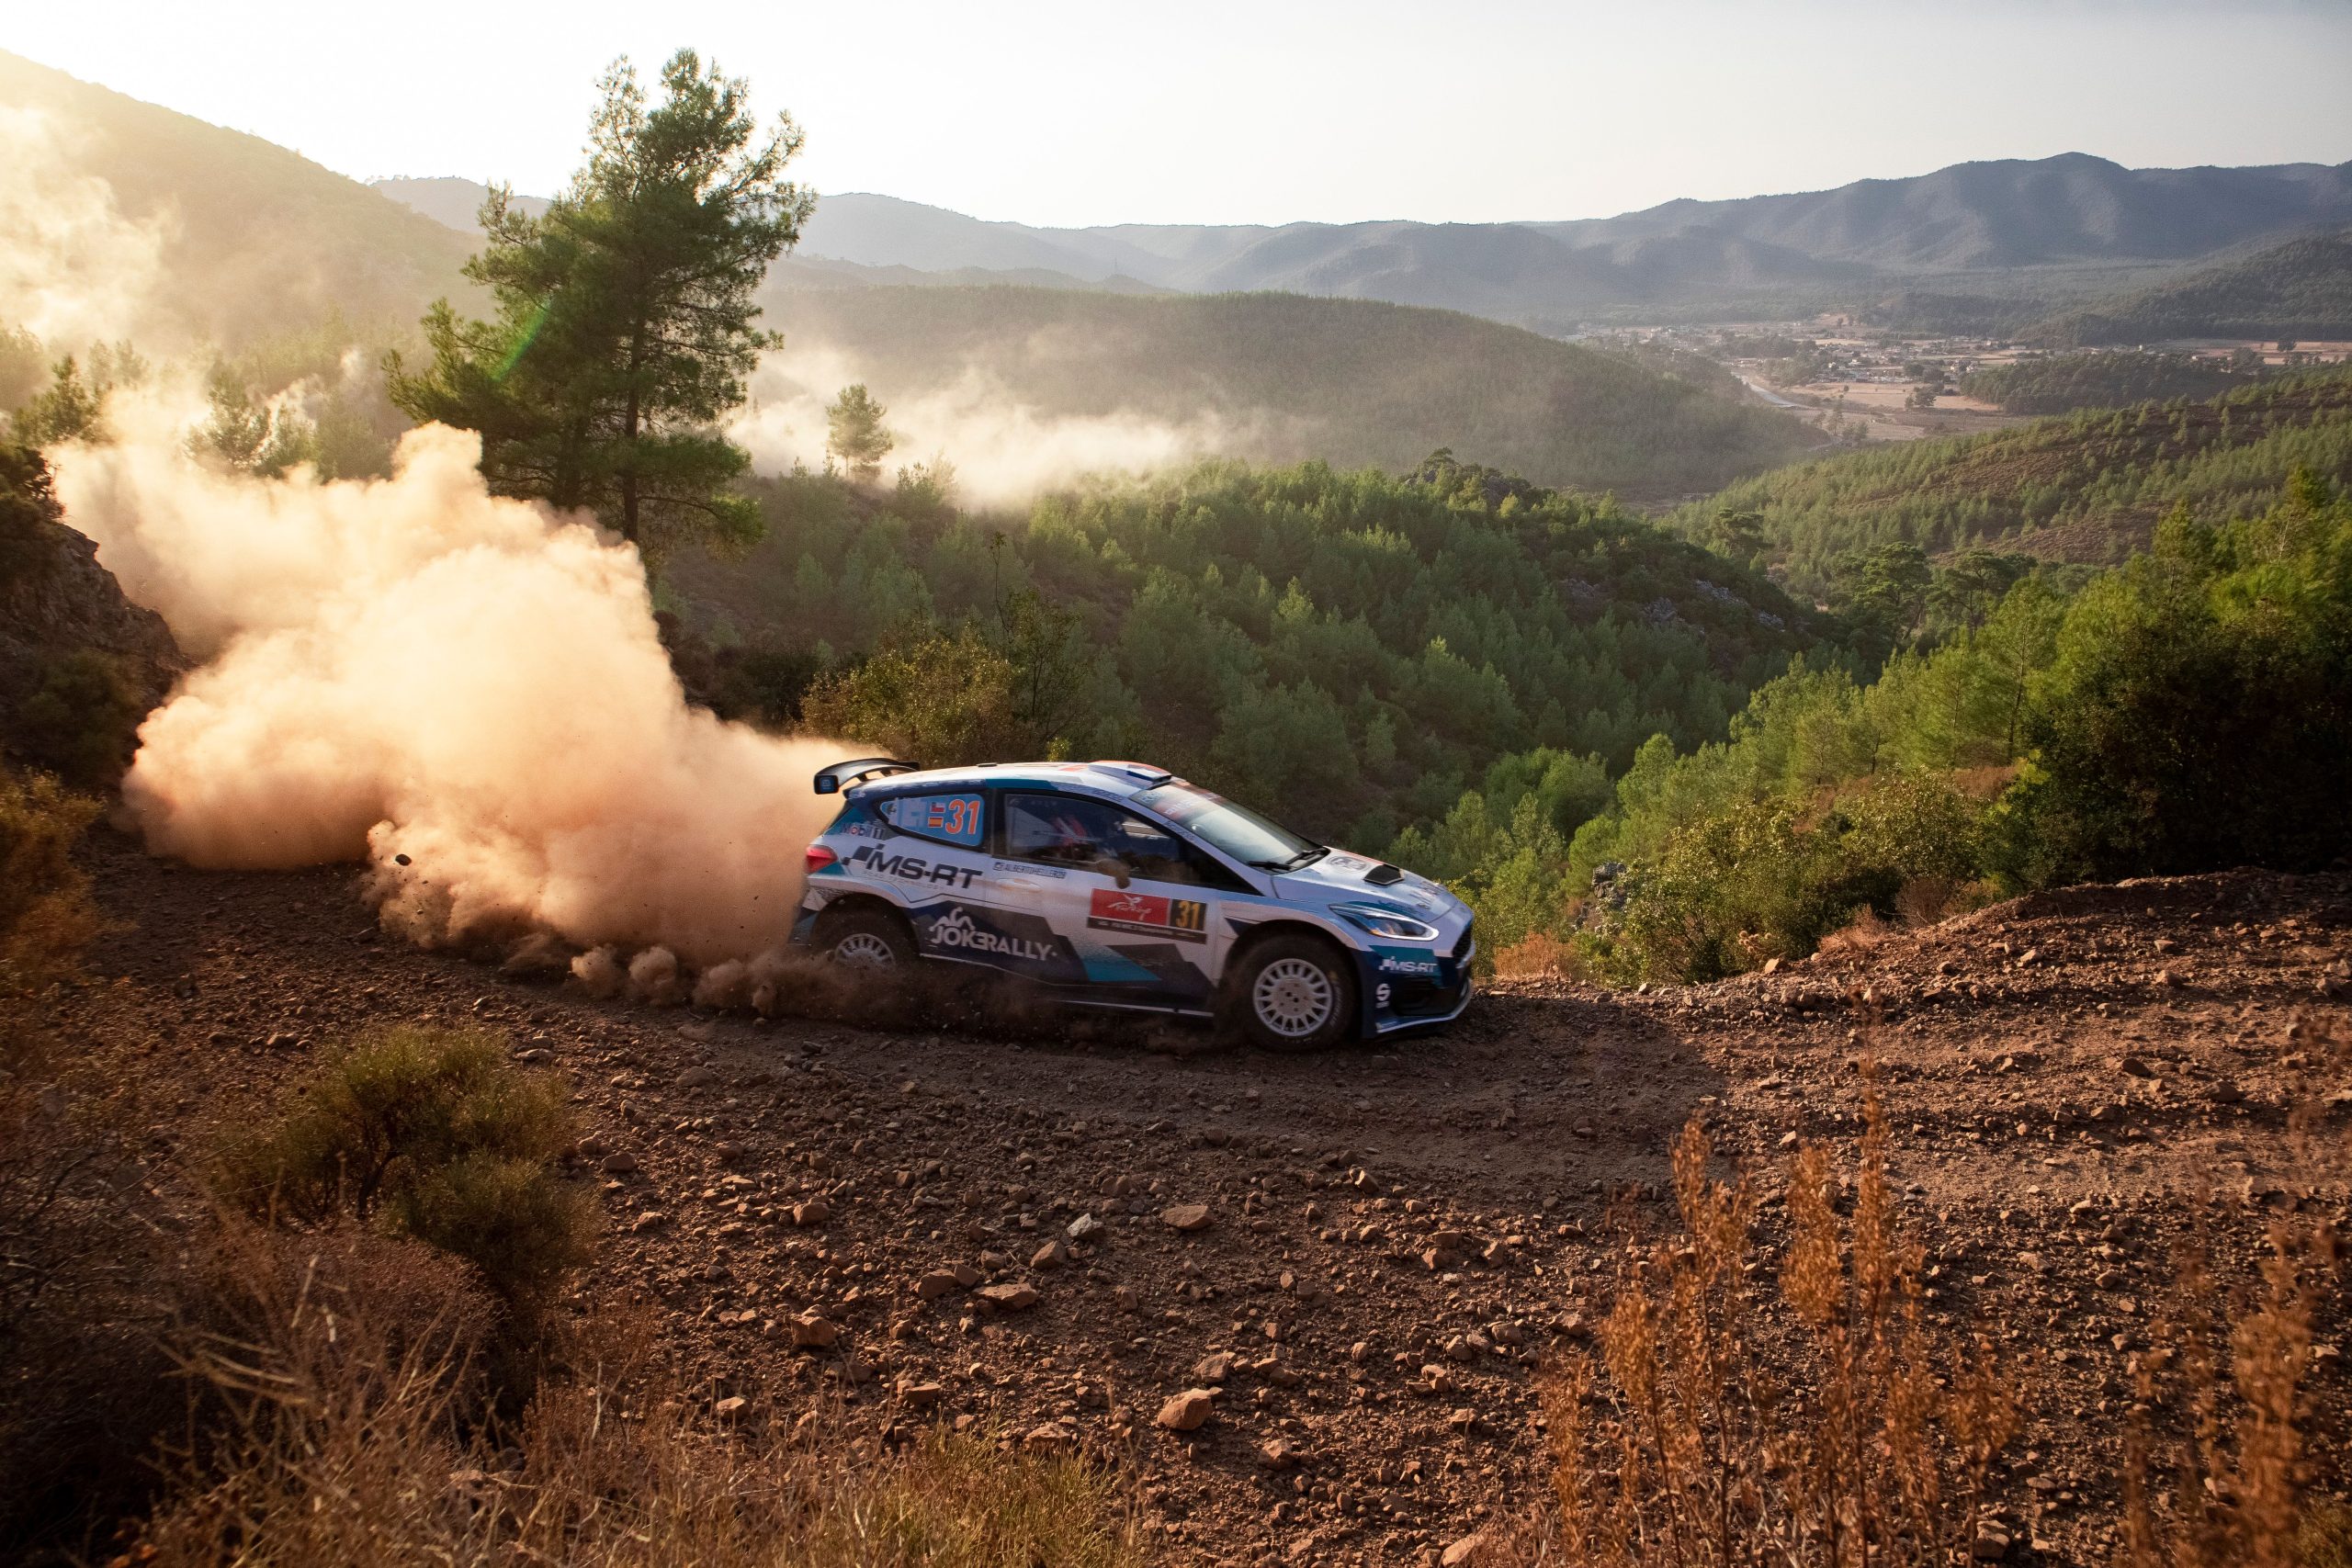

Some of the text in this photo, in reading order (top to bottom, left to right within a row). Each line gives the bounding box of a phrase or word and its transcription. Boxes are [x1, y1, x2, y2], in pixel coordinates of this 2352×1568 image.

[945, 798, 980, 835] 31
[865, 851, 983, 889] MS-RT
[1175, 900, 1200, 930] 31
[1389, 960, 1438, 973] MS-RT
